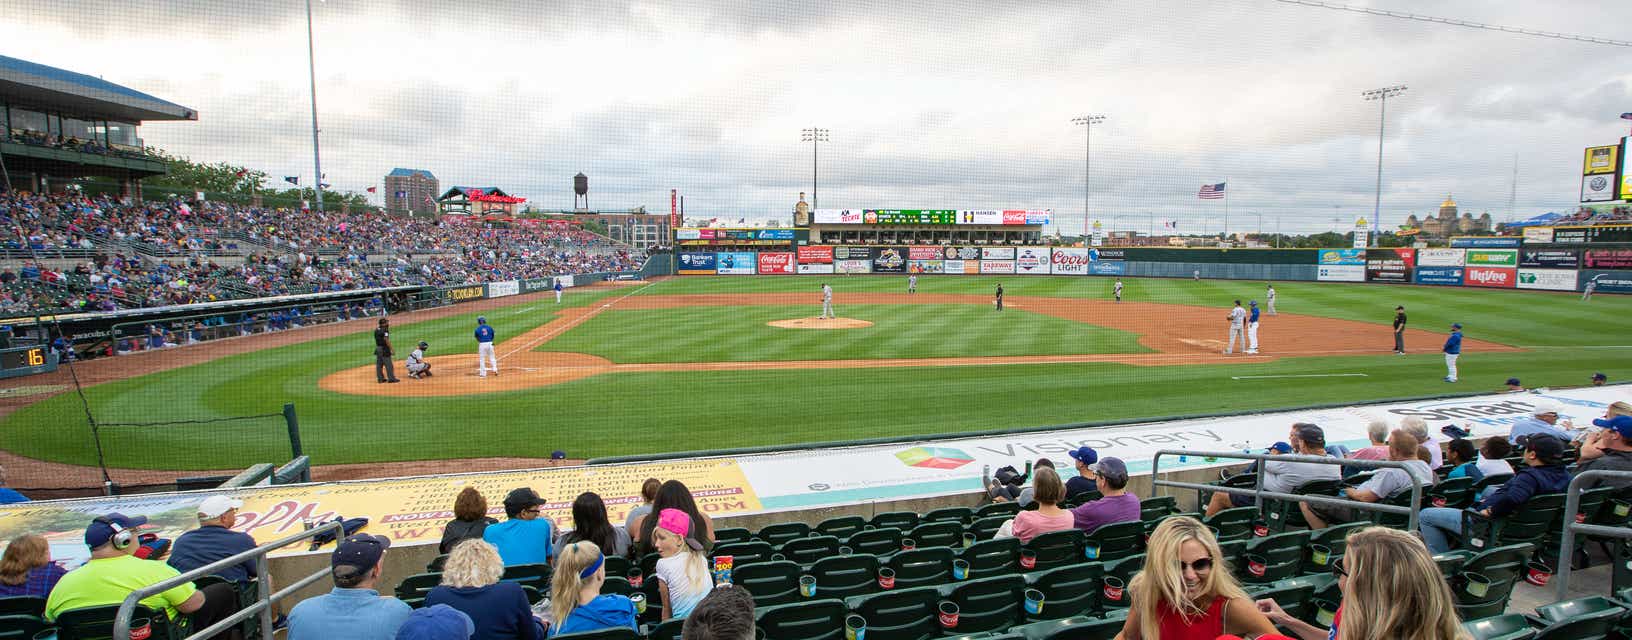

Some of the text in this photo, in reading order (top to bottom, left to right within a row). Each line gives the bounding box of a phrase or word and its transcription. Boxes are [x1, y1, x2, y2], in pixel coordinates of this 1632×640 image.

[761, 254, 787, 264] Coca-Cola
[1052, 250, 1088, 265] Coors
[1472, 253, 1512, 263] SUBWAY
[28, 348, 44, 366] 16
[1388, 400, 1535, 421] Smart
[977, 428, 1223, 457] Visionary
[602, 465, 665, 475] Oakland
[671, 462, 715, 470] Pointe
[389, 512, 438, 521] NOW
